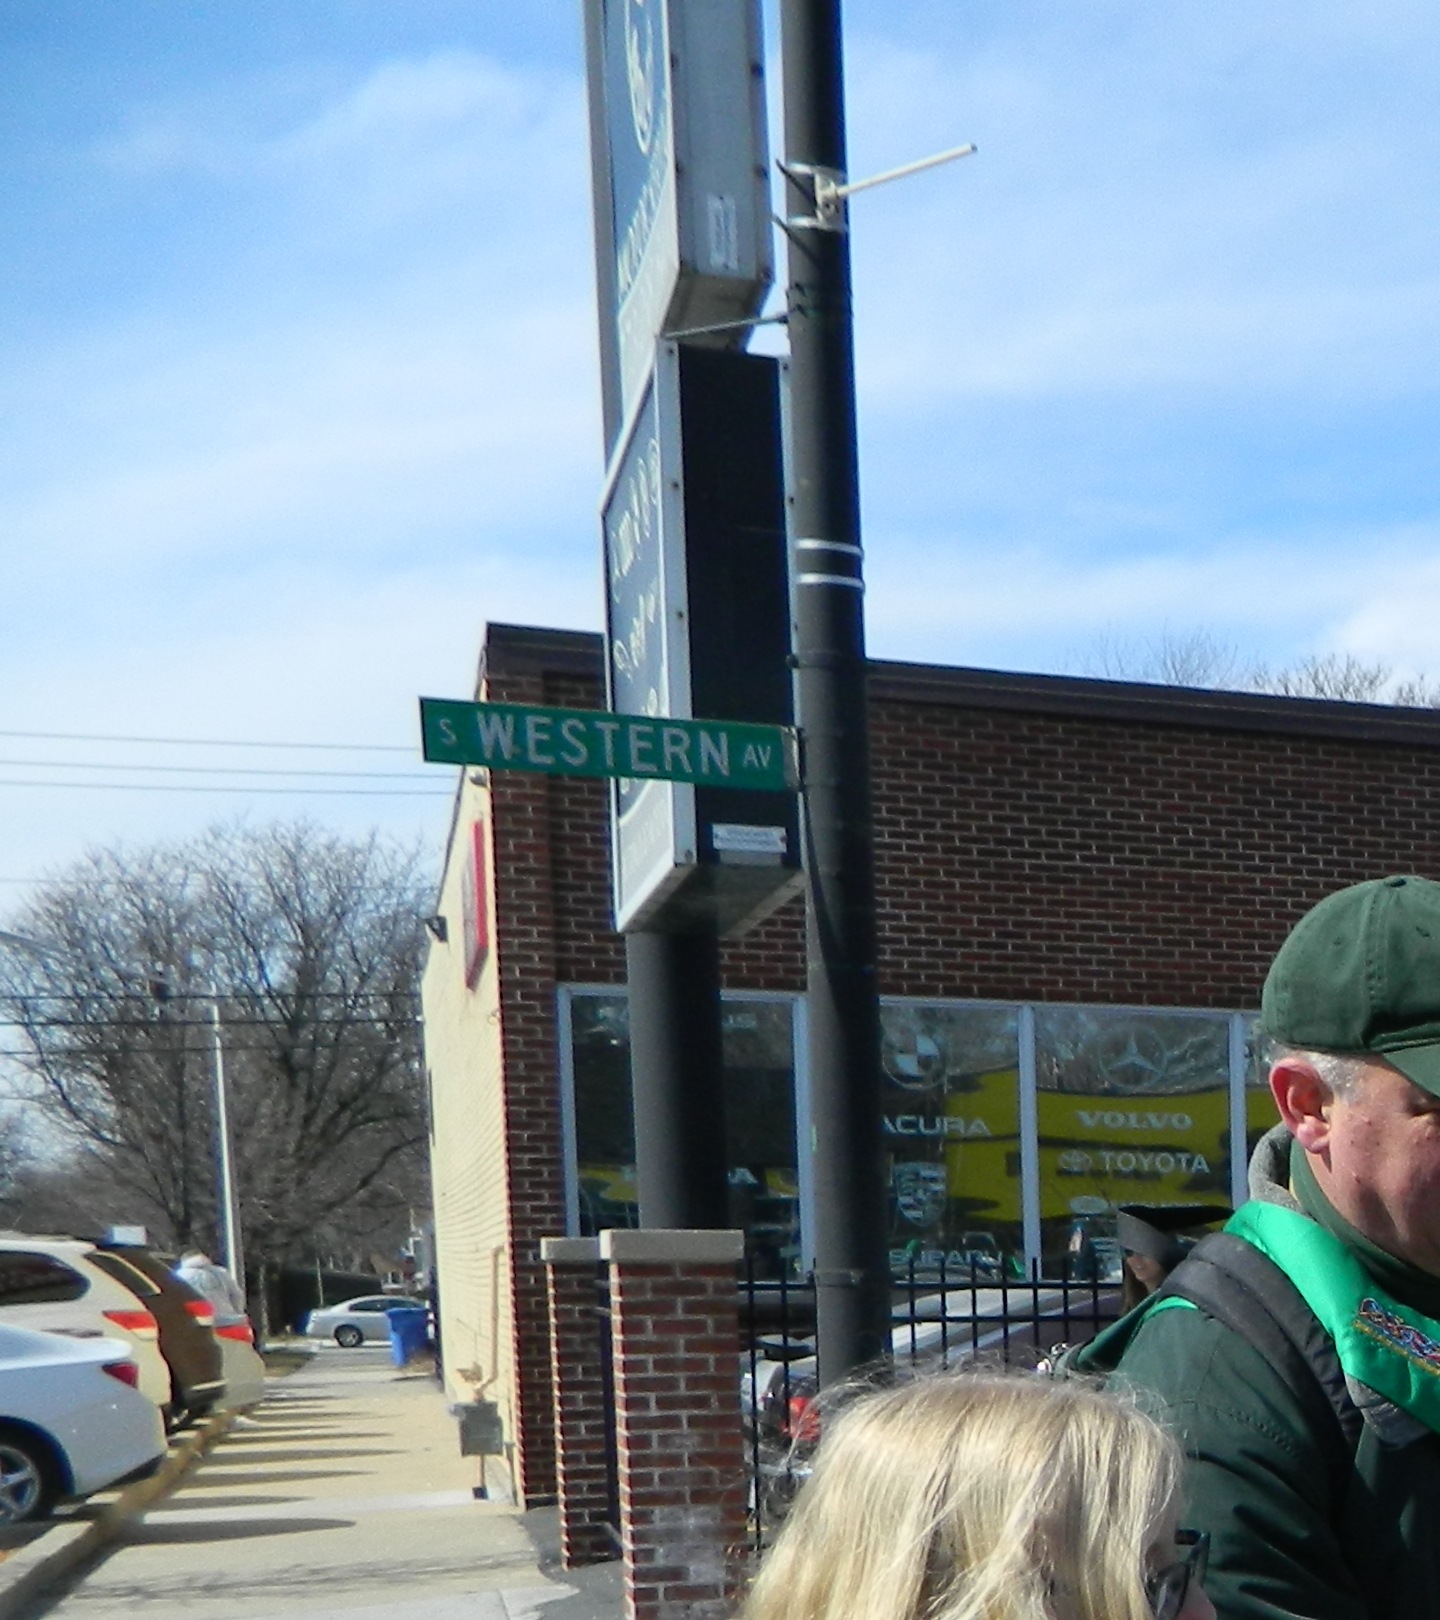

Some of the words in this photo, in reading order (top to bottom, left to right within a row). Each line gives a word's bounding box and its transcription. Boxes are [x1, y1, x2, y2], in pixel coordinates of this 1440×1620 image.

[439, 717, 457, 746] S
[475, 710, 731, 777] WESTERN
[742, 744, 772, 770] AV
[1076, 1110, 1193, 1130] VOLVO
[1101, 1151, 1210, 1174] TOYOTA
